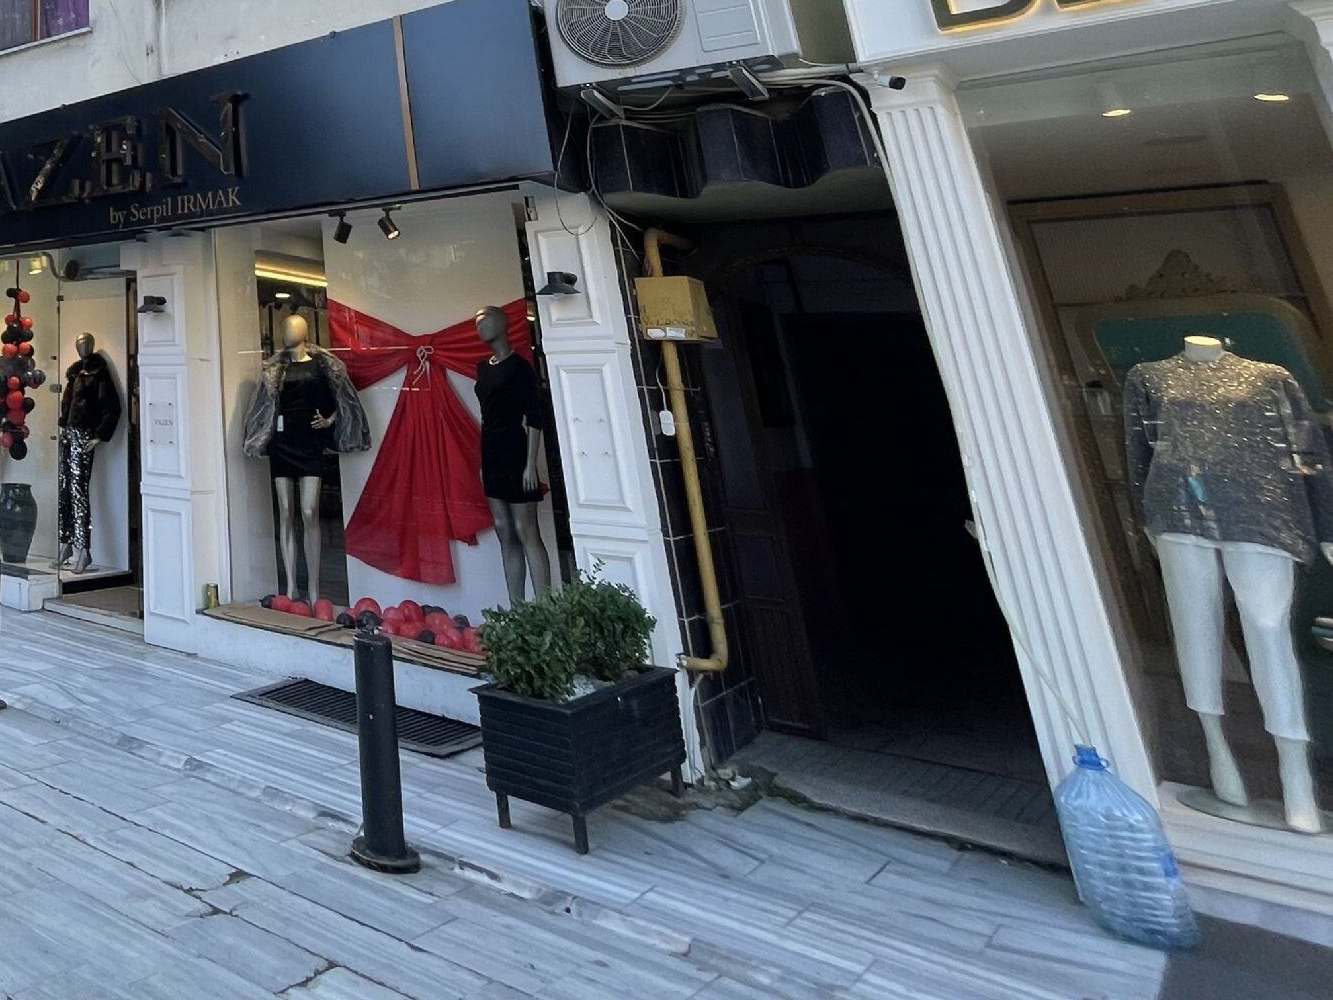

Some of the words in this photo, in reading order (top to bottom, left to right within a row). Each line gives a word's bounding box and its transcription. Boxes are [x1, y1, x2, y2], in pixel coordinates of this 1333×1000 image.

[109, 206, 127, 229] by
[129, 197, 172, 223] Serpil
[176, 185, 242, 215] IRMAK
